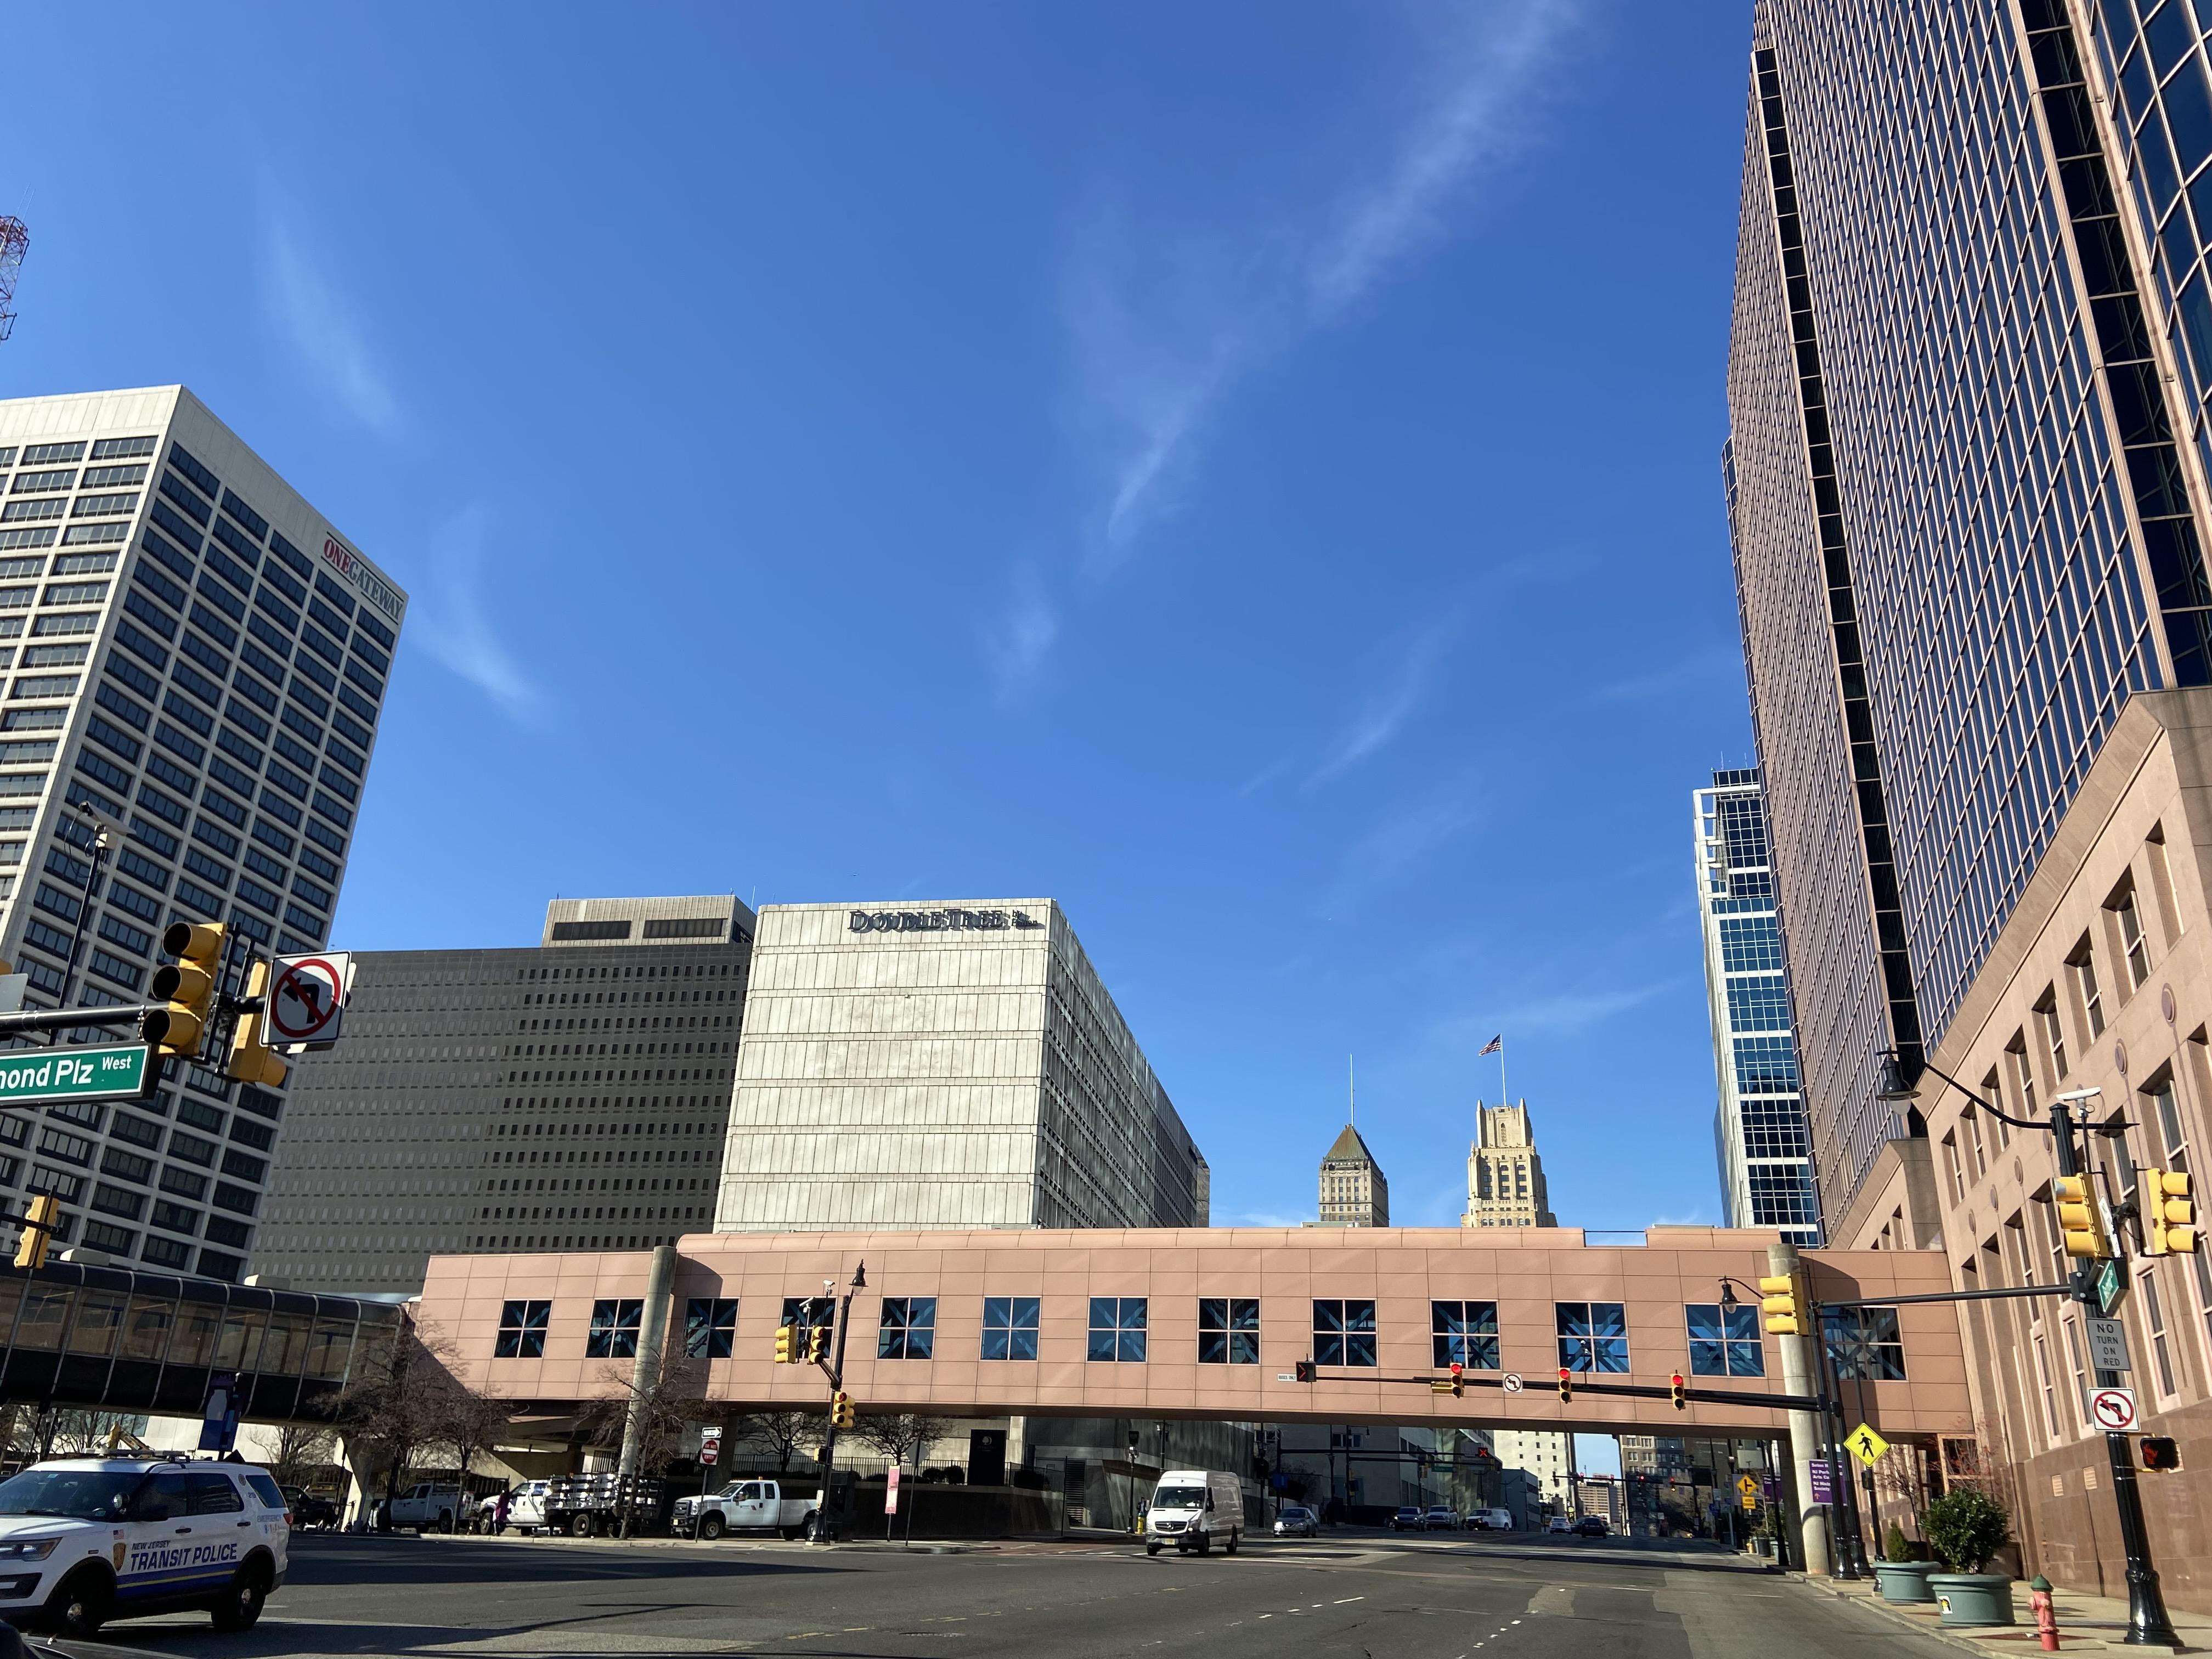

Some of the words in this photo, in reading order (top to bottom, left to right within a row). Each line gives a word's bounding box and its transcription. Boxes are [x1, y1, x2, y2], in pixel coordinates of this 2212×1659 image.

[54, 1059, 94, 1086] Plz
[102, 1055, 132, 1070] West
[2097, 1324, 2114, 1333] NO
[2096, 1336, 2118, 1344] TURN
[2103, 1358, 2120, 1366] RED
[132, 1542, 146, 1550] NEW
[148, 1540, 171, 1549] JERSEY
[131, 1548, 192, 1571] TRANSIT
[193, 1543, 238, 1564] POLICE
